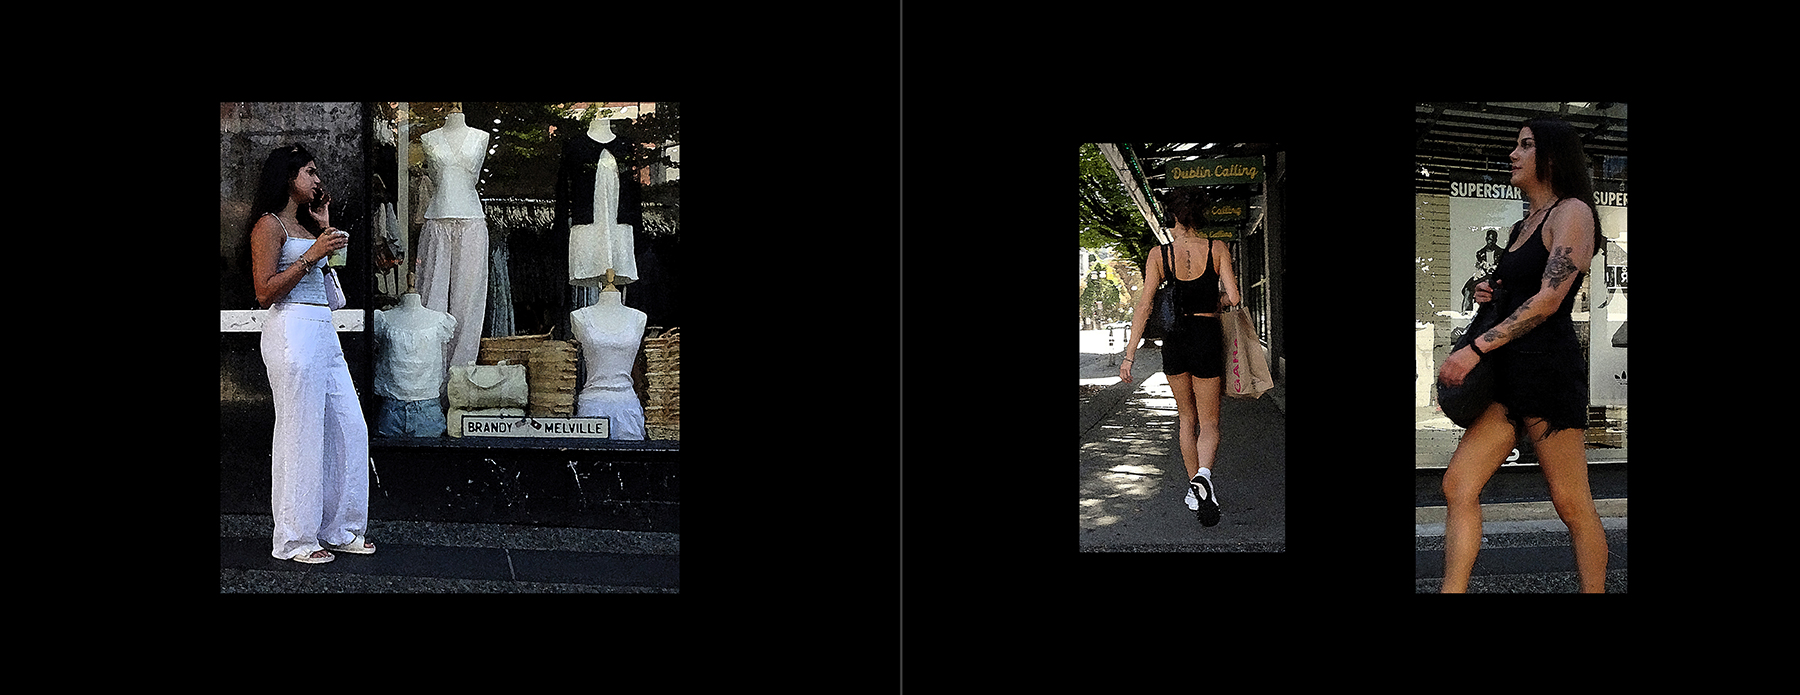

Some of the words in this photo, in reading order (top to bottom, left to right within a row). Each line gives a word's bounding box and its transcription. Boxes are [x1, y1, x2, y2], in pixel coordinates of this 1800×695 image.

[1171, 166, 1212, 180] Dublin
[1214, 164, 1259, 179] Calling
[1450, 181, 1522, 199] SUPERSTAR
[467, 421, 513, 433] BRANDY
[544, 422, 603, 434] MELVILLE
